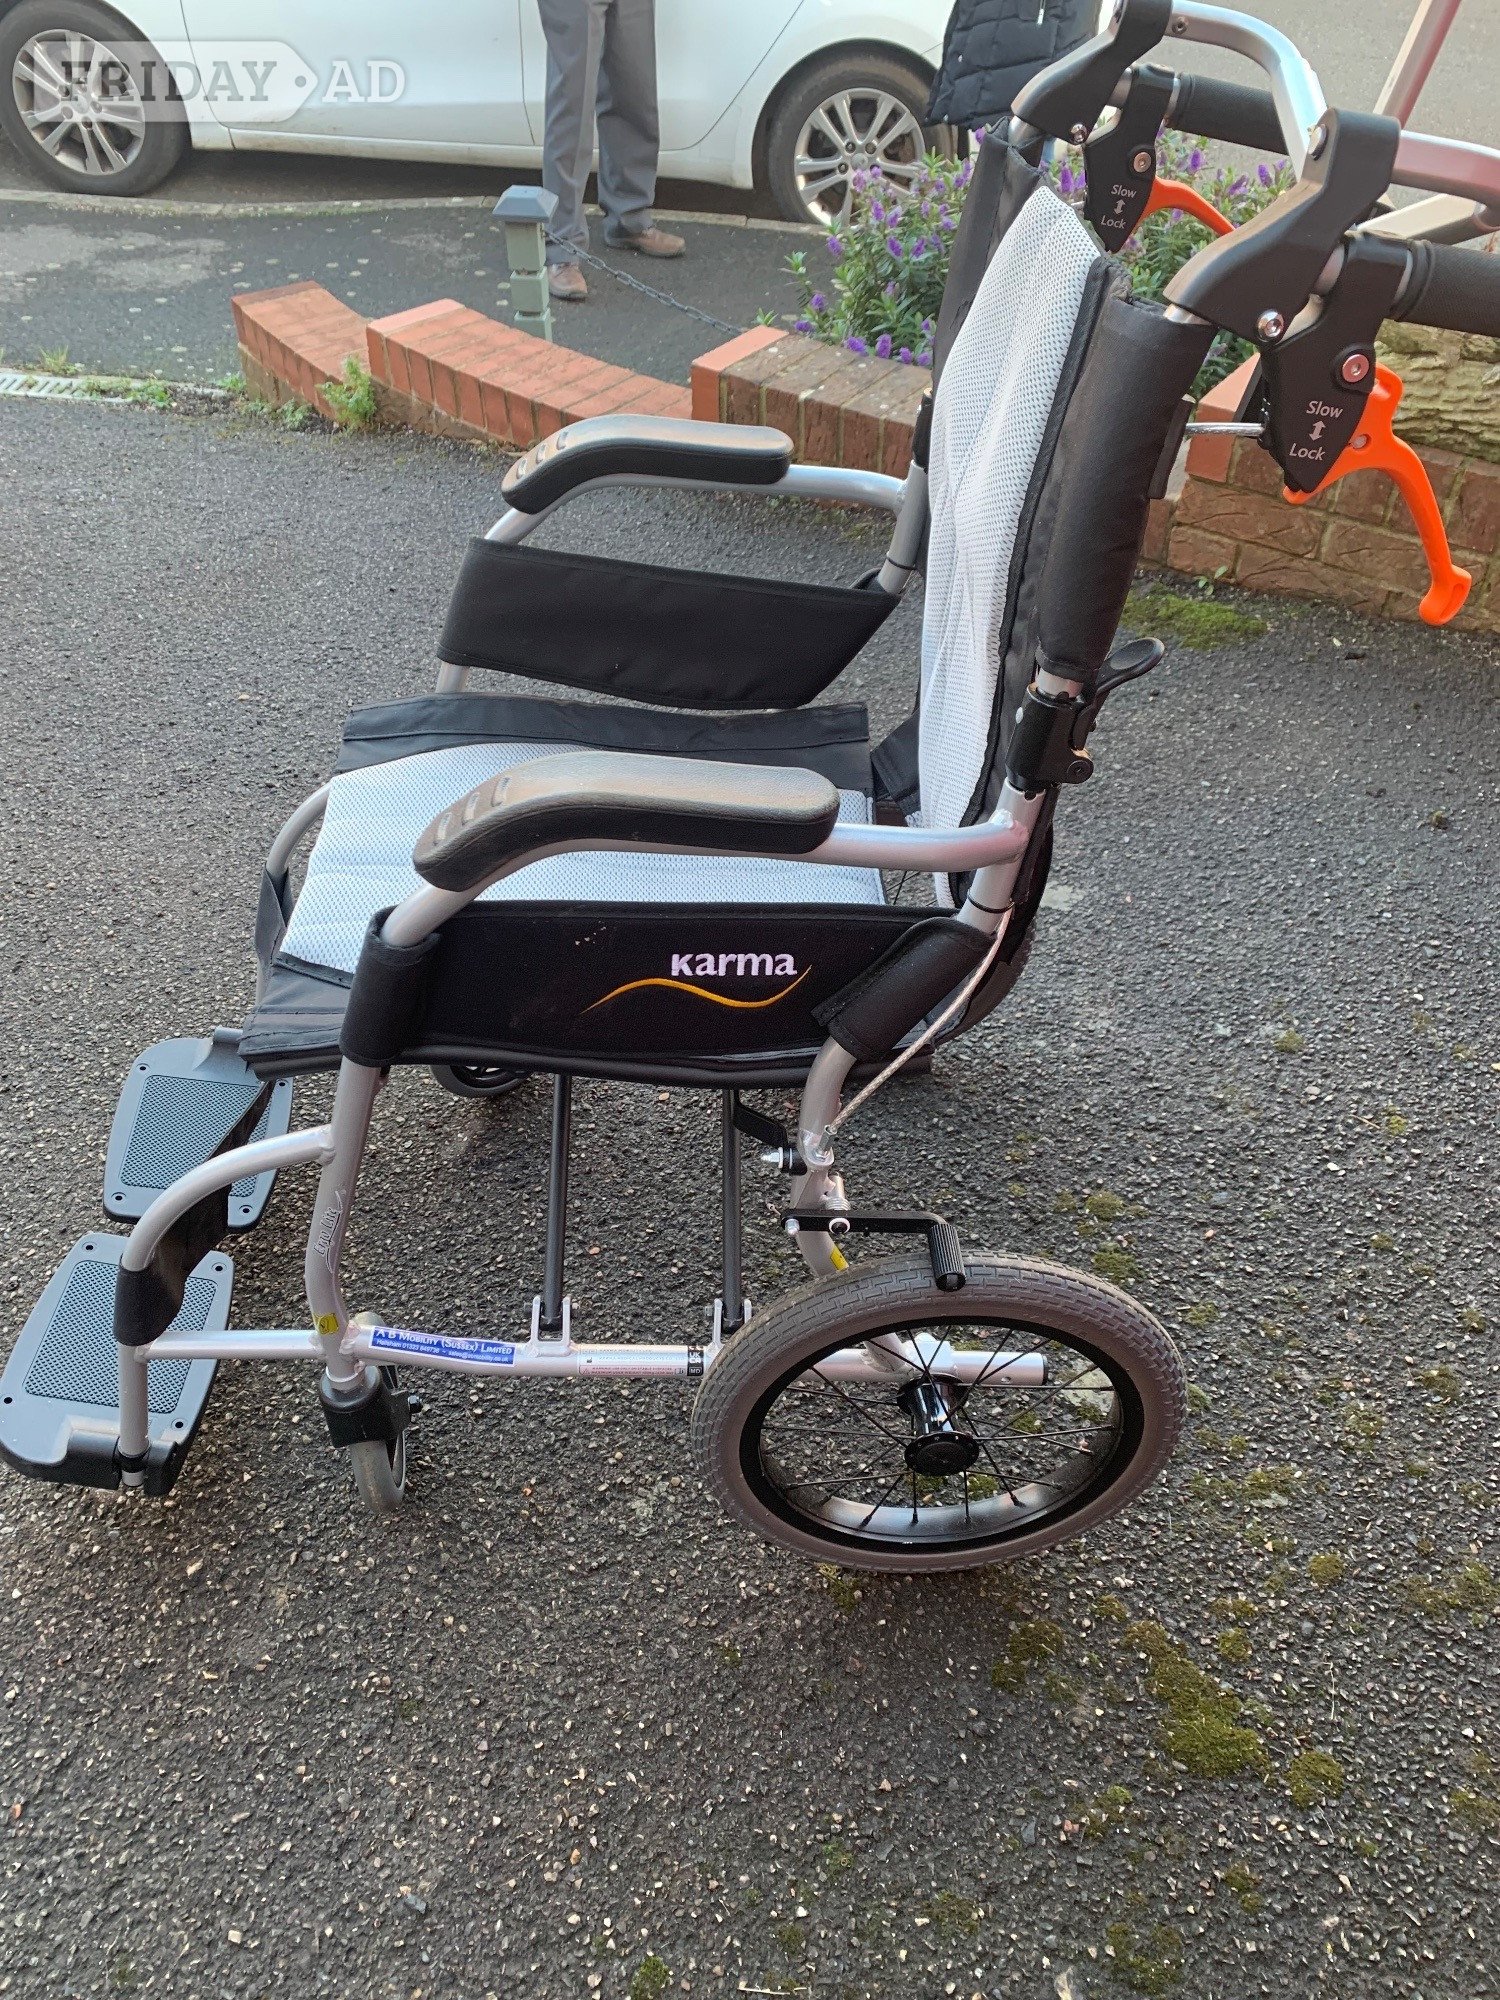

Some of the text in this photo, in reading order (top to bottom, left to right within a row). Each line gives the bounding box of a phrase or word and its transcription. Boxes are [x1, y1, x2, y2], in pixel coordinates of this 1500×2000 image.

[1111, 184, 1137, 198] Slow
[1100, 215, 1126, 229] Lock
[1306, 401, 1343, 418] Slow
[1289, 443, 1325, 460] Lock
[320, 1206, 338, 1231] Lite
[376, 1329, 513, 1355] A B MOBILITY (SUSSEX) LIMITED
